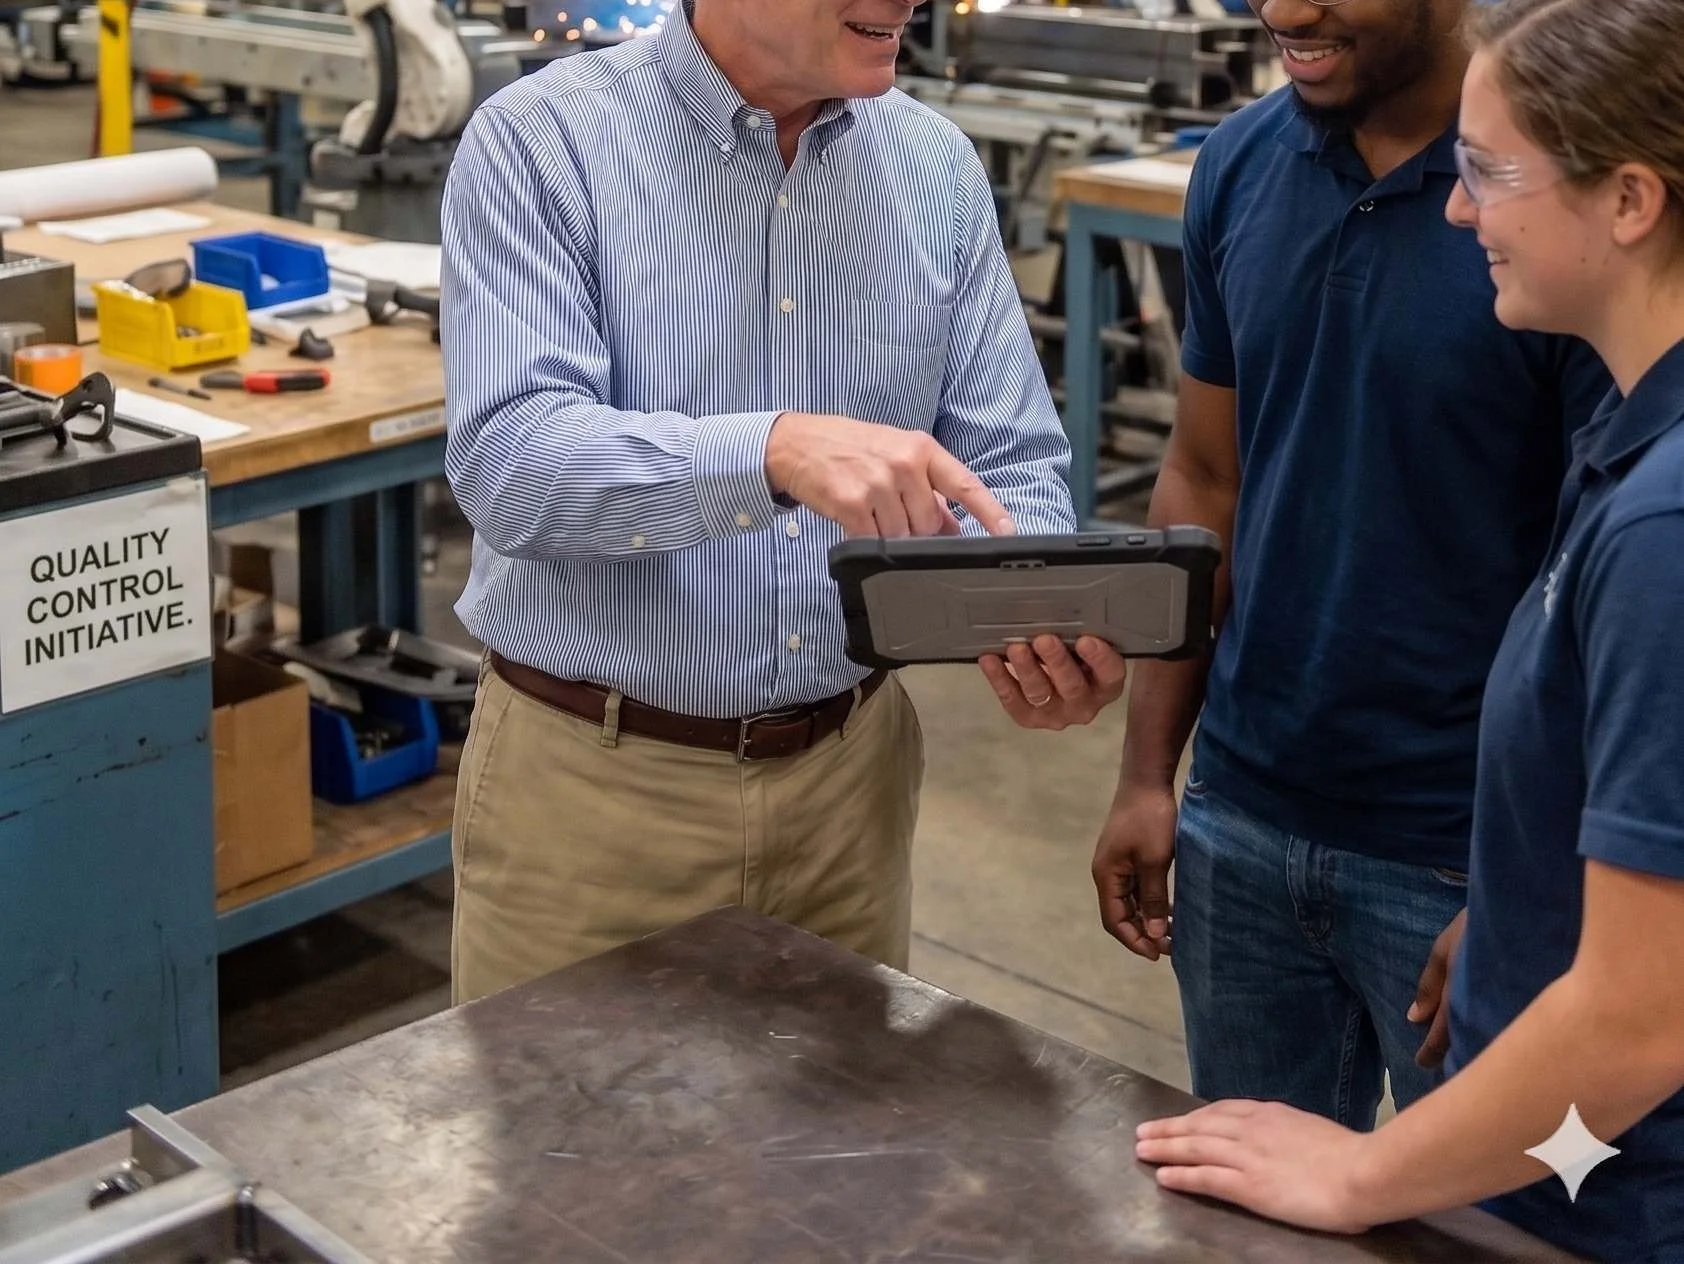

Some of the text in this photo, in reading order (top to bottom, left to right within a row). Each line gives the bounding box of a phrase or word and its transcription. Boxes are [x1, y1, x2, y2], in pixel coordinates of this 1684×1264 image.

[31, 528, 170, 583] QUALITY
[27, 566, 183, 624] CONTROL
[25, 601, 193, 666] INITIATIVE.
